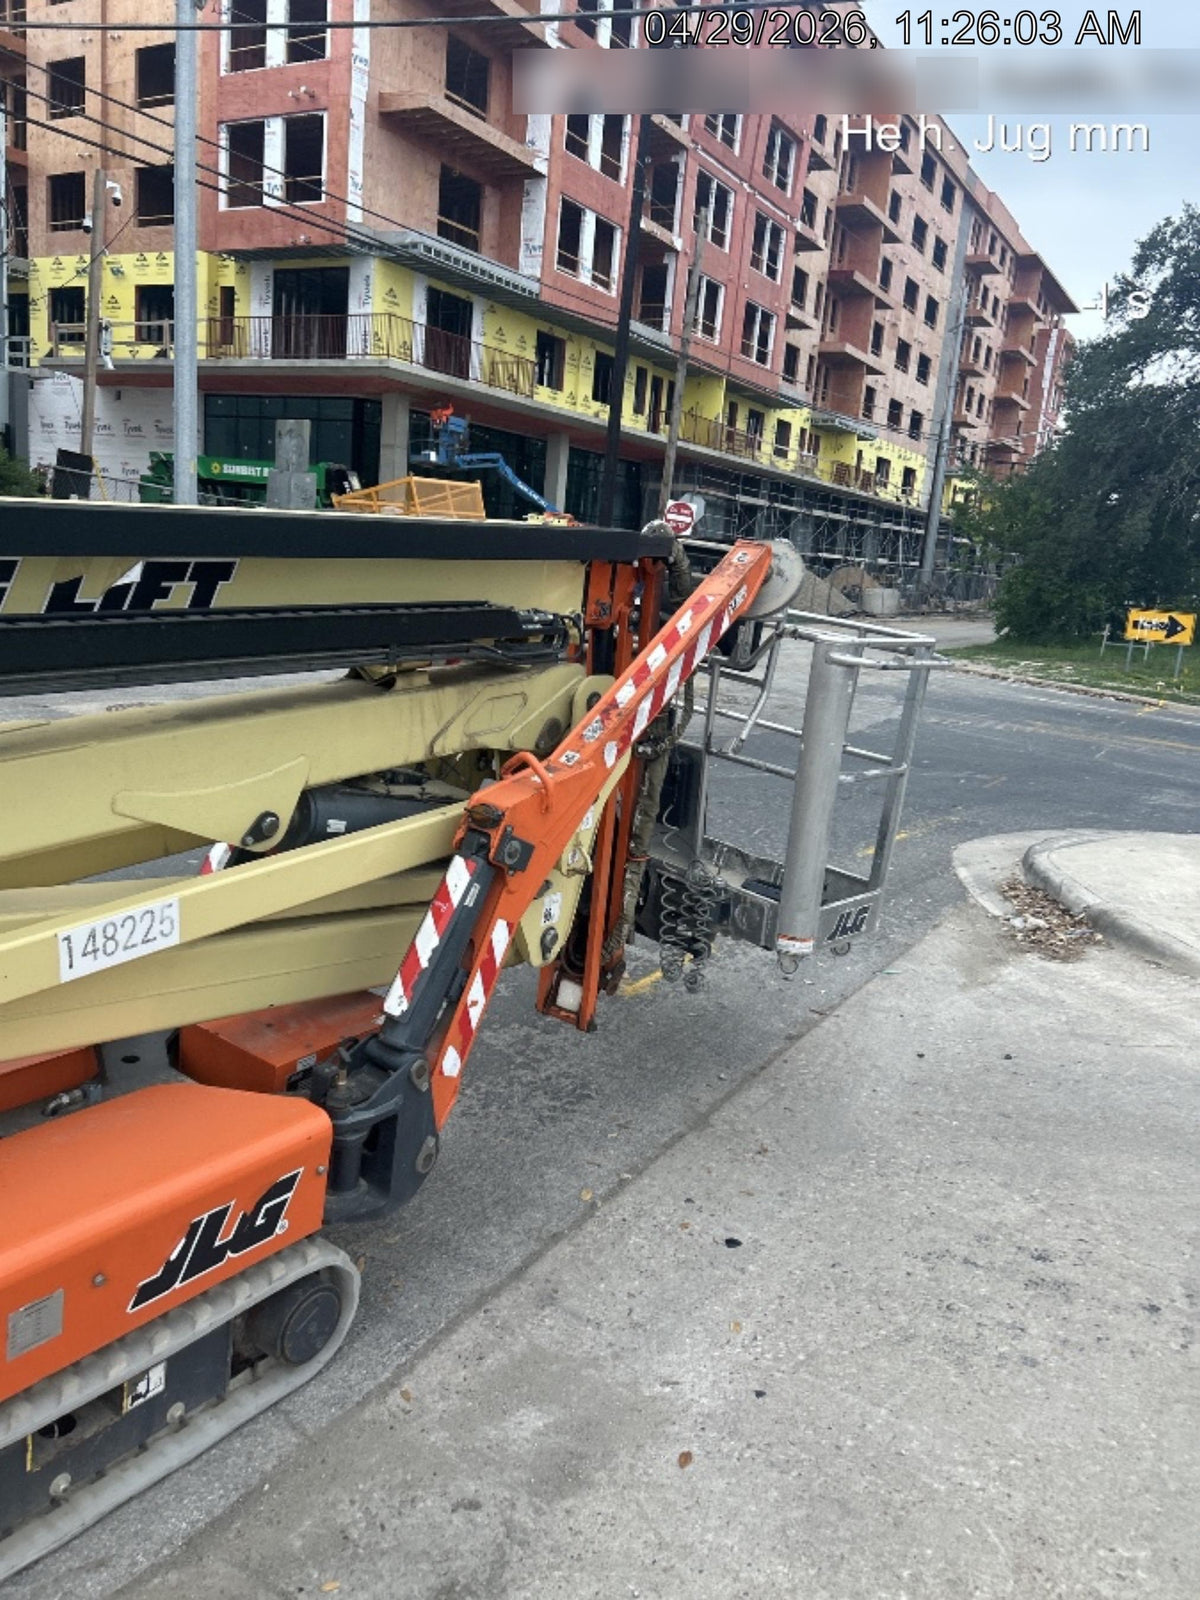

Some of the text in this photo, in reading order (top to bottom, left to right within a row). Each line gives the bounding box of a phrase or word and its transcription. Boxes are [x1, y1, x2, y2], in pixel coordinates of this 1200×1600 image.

[61, 902, 175, 970] 148225
[823, 903, 872, 944] JLG
[126, 1166, 304, 1313] JLG
